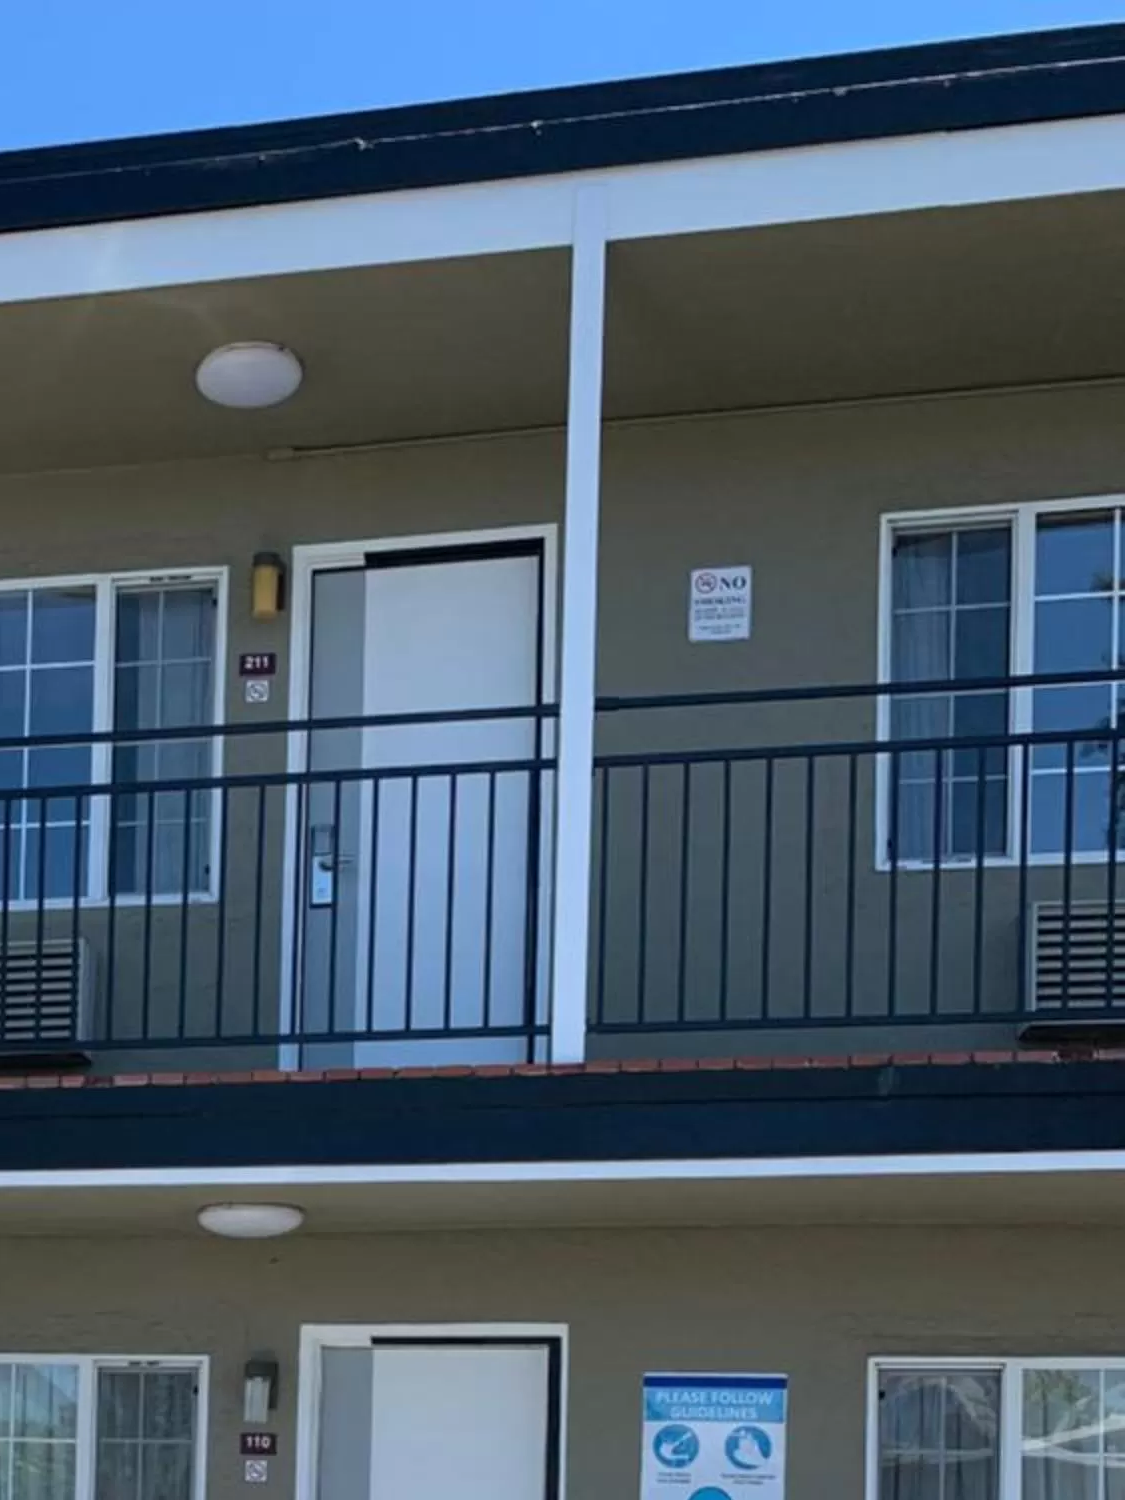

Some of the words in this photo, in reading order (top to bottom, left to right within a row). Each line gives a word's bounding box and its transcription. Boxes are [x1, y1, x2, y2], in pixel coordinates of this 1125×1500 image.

[719, 574, 747, 591] NO
[694, 596, 747, 605] SMOKING
[243, 655, 268, 669] 211
[655, 1391, 707, 1404] PLEASE
[712, 1391, 774, 1405] FOLLOW
[246, 1436, 271, 1449] 110
